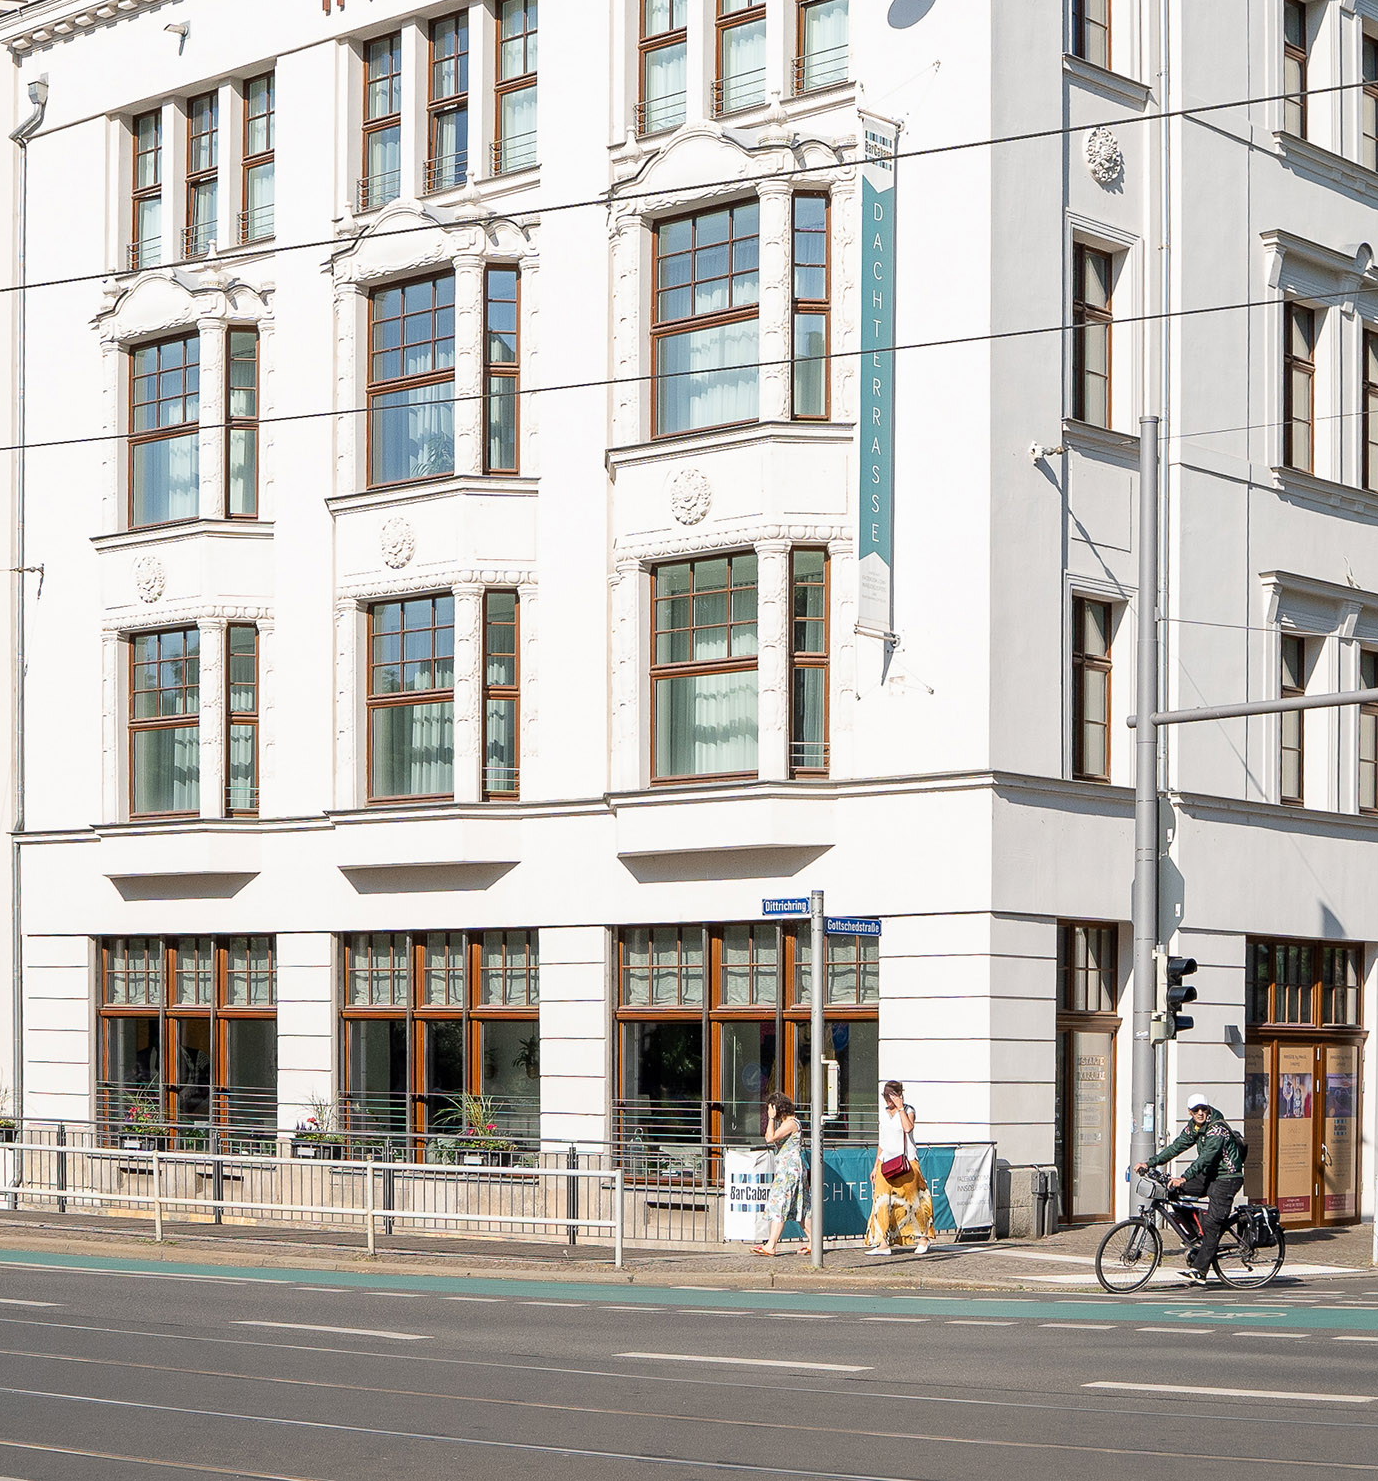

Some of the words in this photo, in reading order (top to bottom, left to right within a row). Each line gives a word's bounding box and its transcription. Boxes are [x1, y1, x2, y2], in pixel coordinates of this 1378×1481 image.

[870, 202, 884, 544] DACHTERRASSE
[765, 900, 807, 913] Dittrichring
[827, 919, 880, 933] Gottschedstraße
